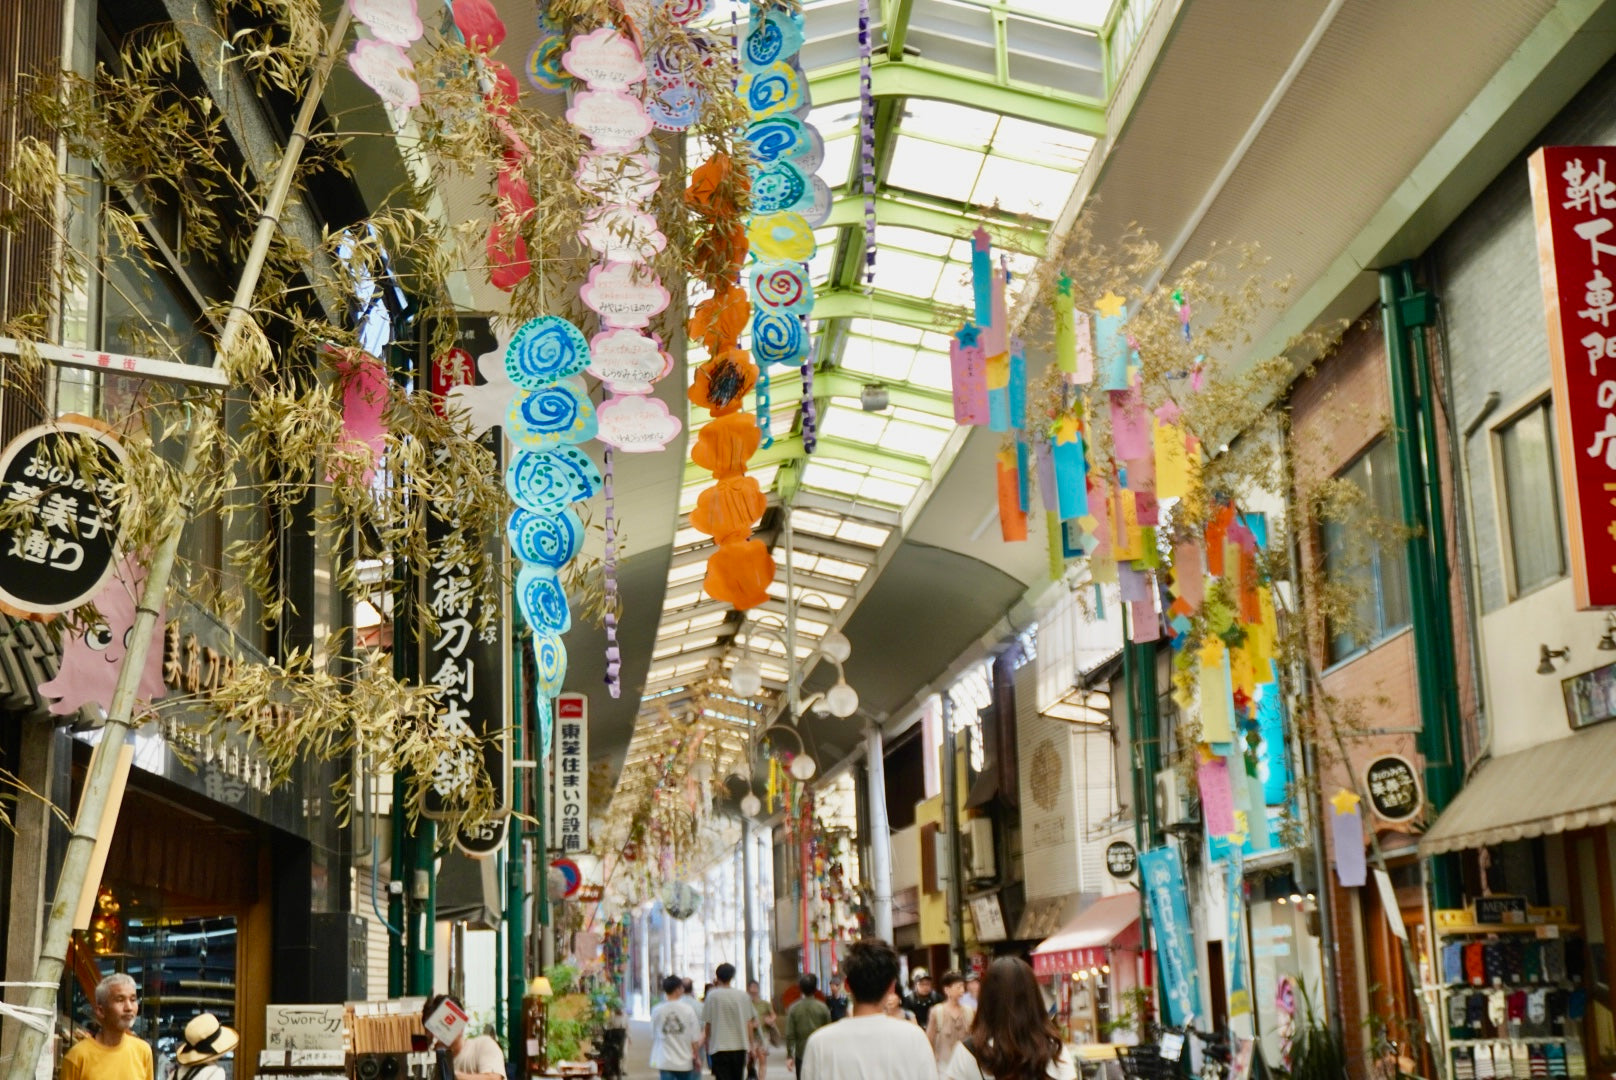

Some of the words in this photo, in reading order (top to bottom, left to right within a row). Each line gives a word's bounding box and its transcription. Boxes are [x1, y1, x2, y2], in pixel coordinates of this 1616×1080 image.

[71, 354, 137, 371] 一番街
[7, 527, 85, 572] 通り
[562, 724, 580, 850] 東芝住まいの設備
